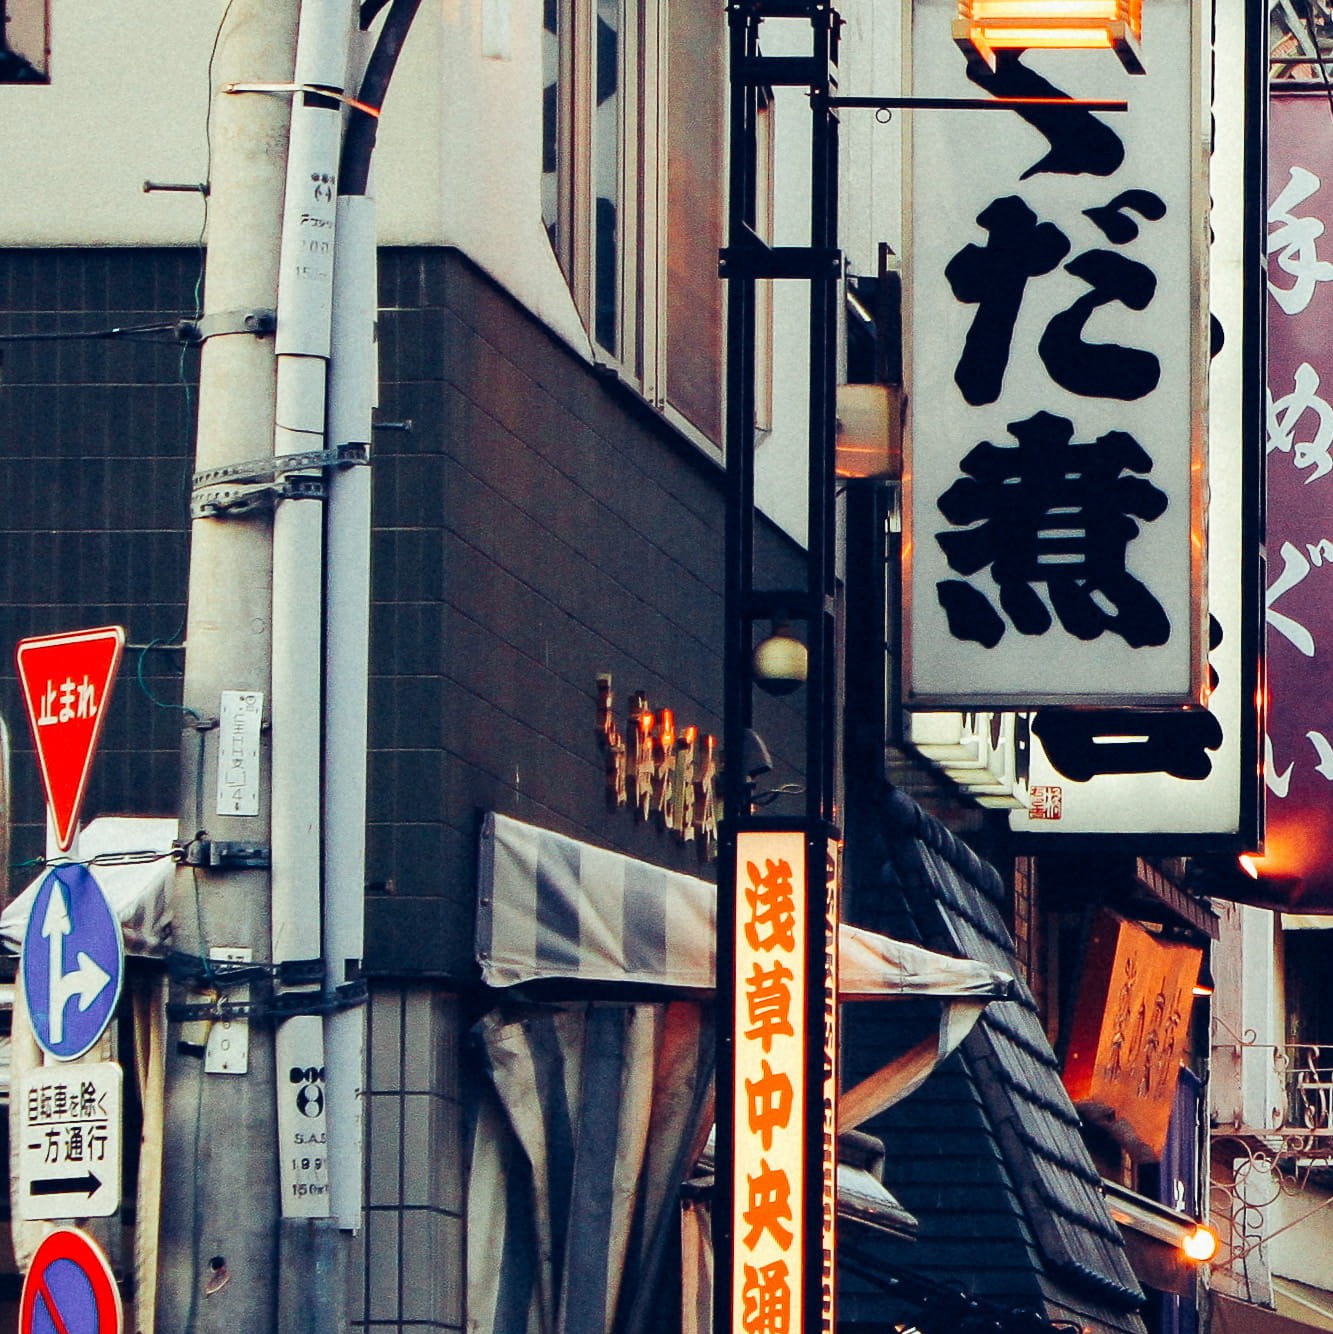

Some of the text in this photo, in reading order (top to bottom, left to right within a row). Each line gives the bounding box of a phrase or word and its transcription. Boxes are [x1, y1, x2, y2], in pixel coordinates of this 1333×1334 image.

[37, 674, 98, 726] 止まれ
[28, 1081, 108, 1122] 自転車を除く
[28, 1124, 109, 1164] 一方通行
